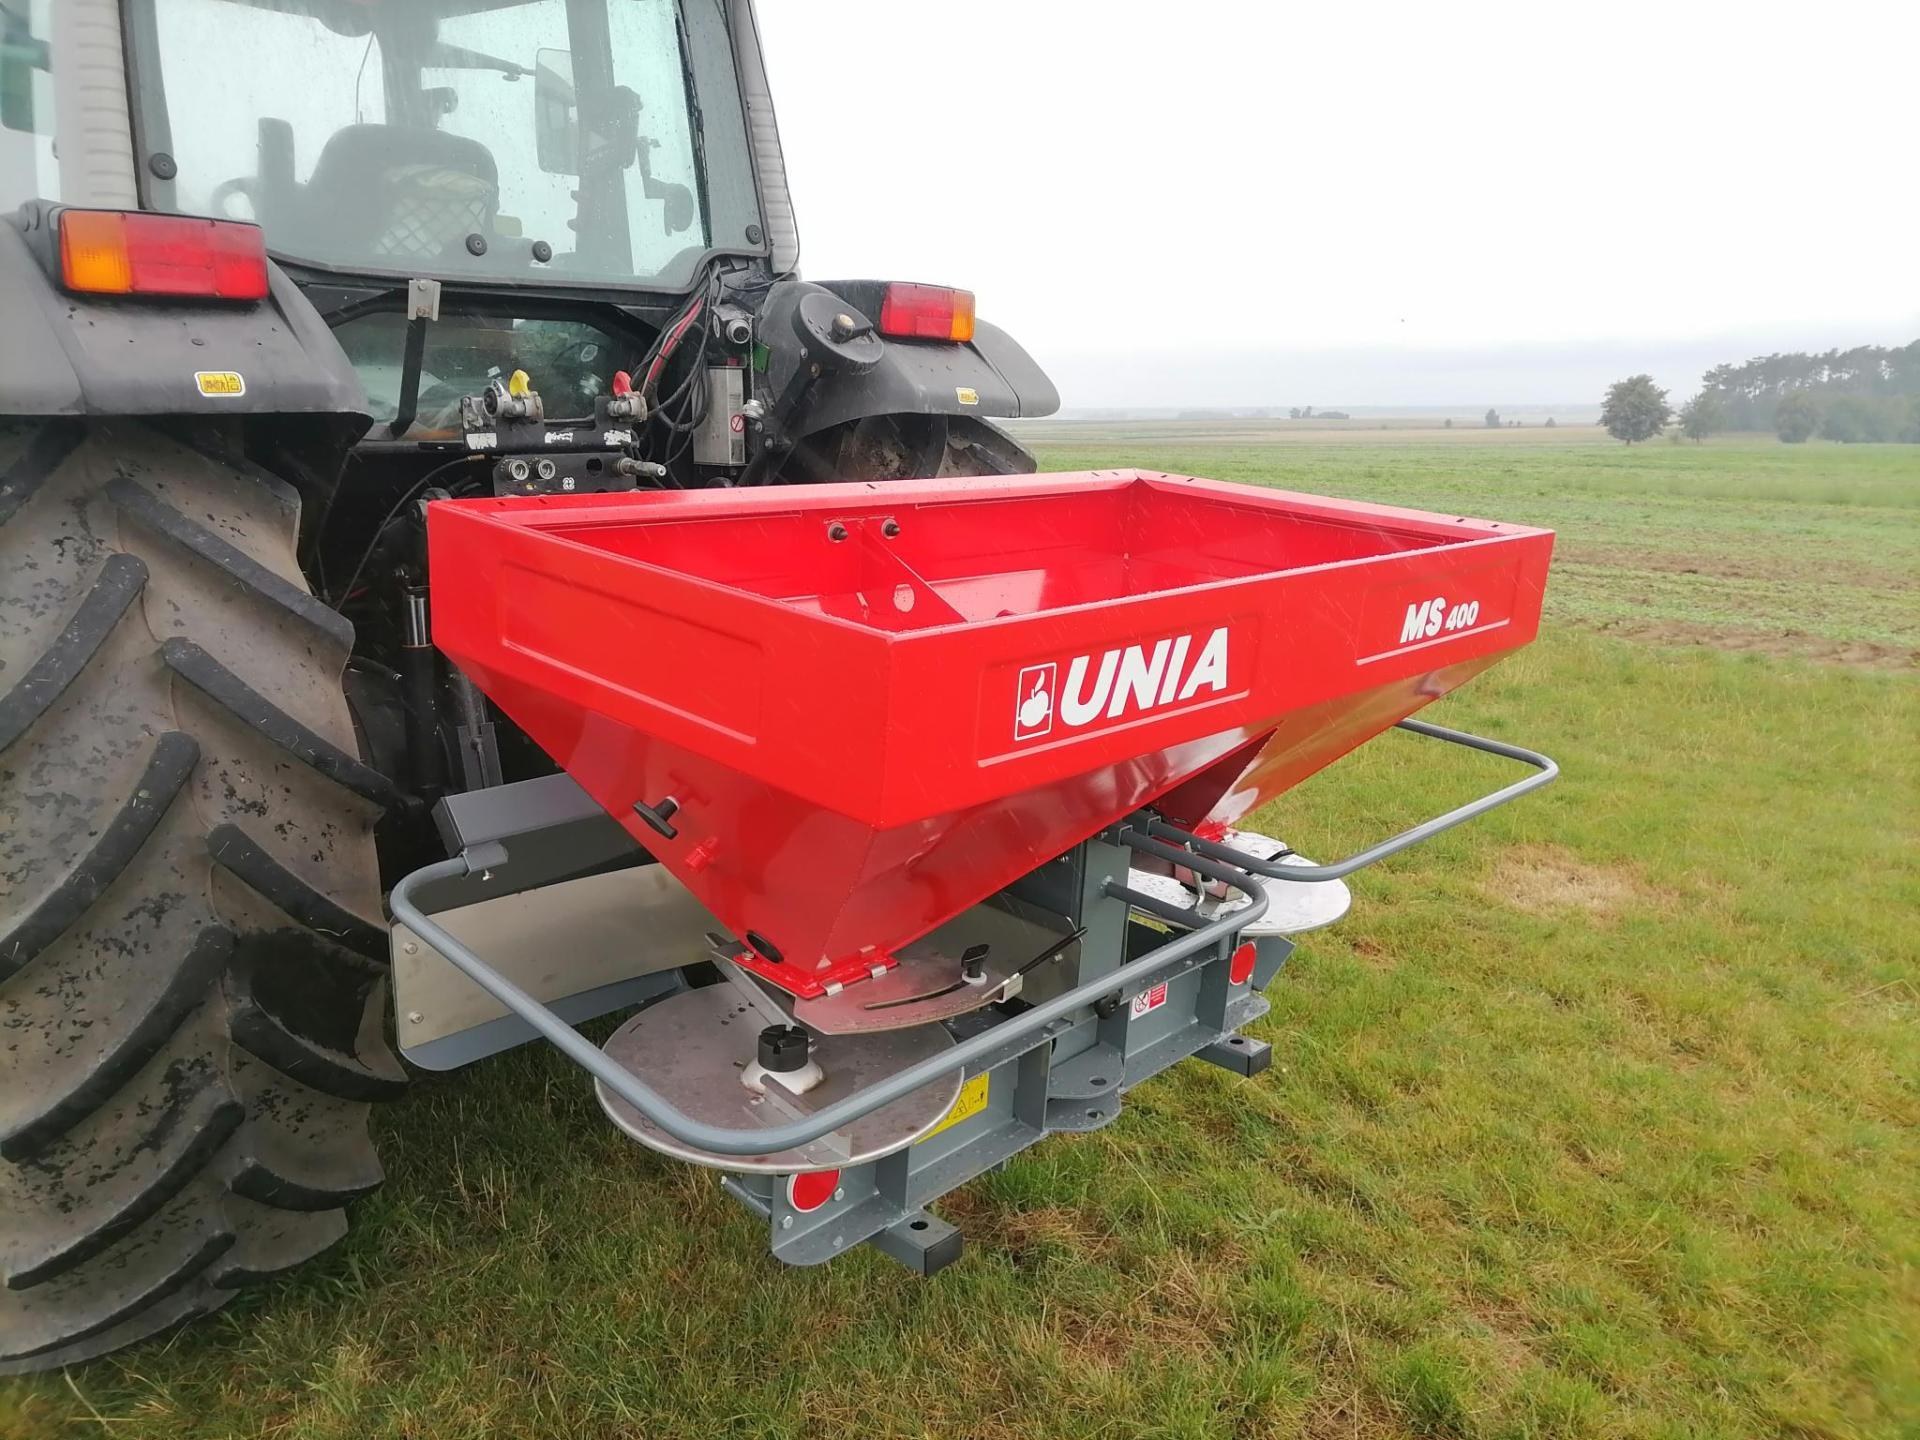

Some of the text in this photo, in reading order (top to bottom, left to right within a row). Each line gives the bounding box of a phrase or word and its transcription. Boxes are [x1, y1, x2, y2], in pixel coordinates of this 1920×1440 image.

[1399, 597, 1480, 644] MS 400
[1060, 627, 1228, 727] UNIA
